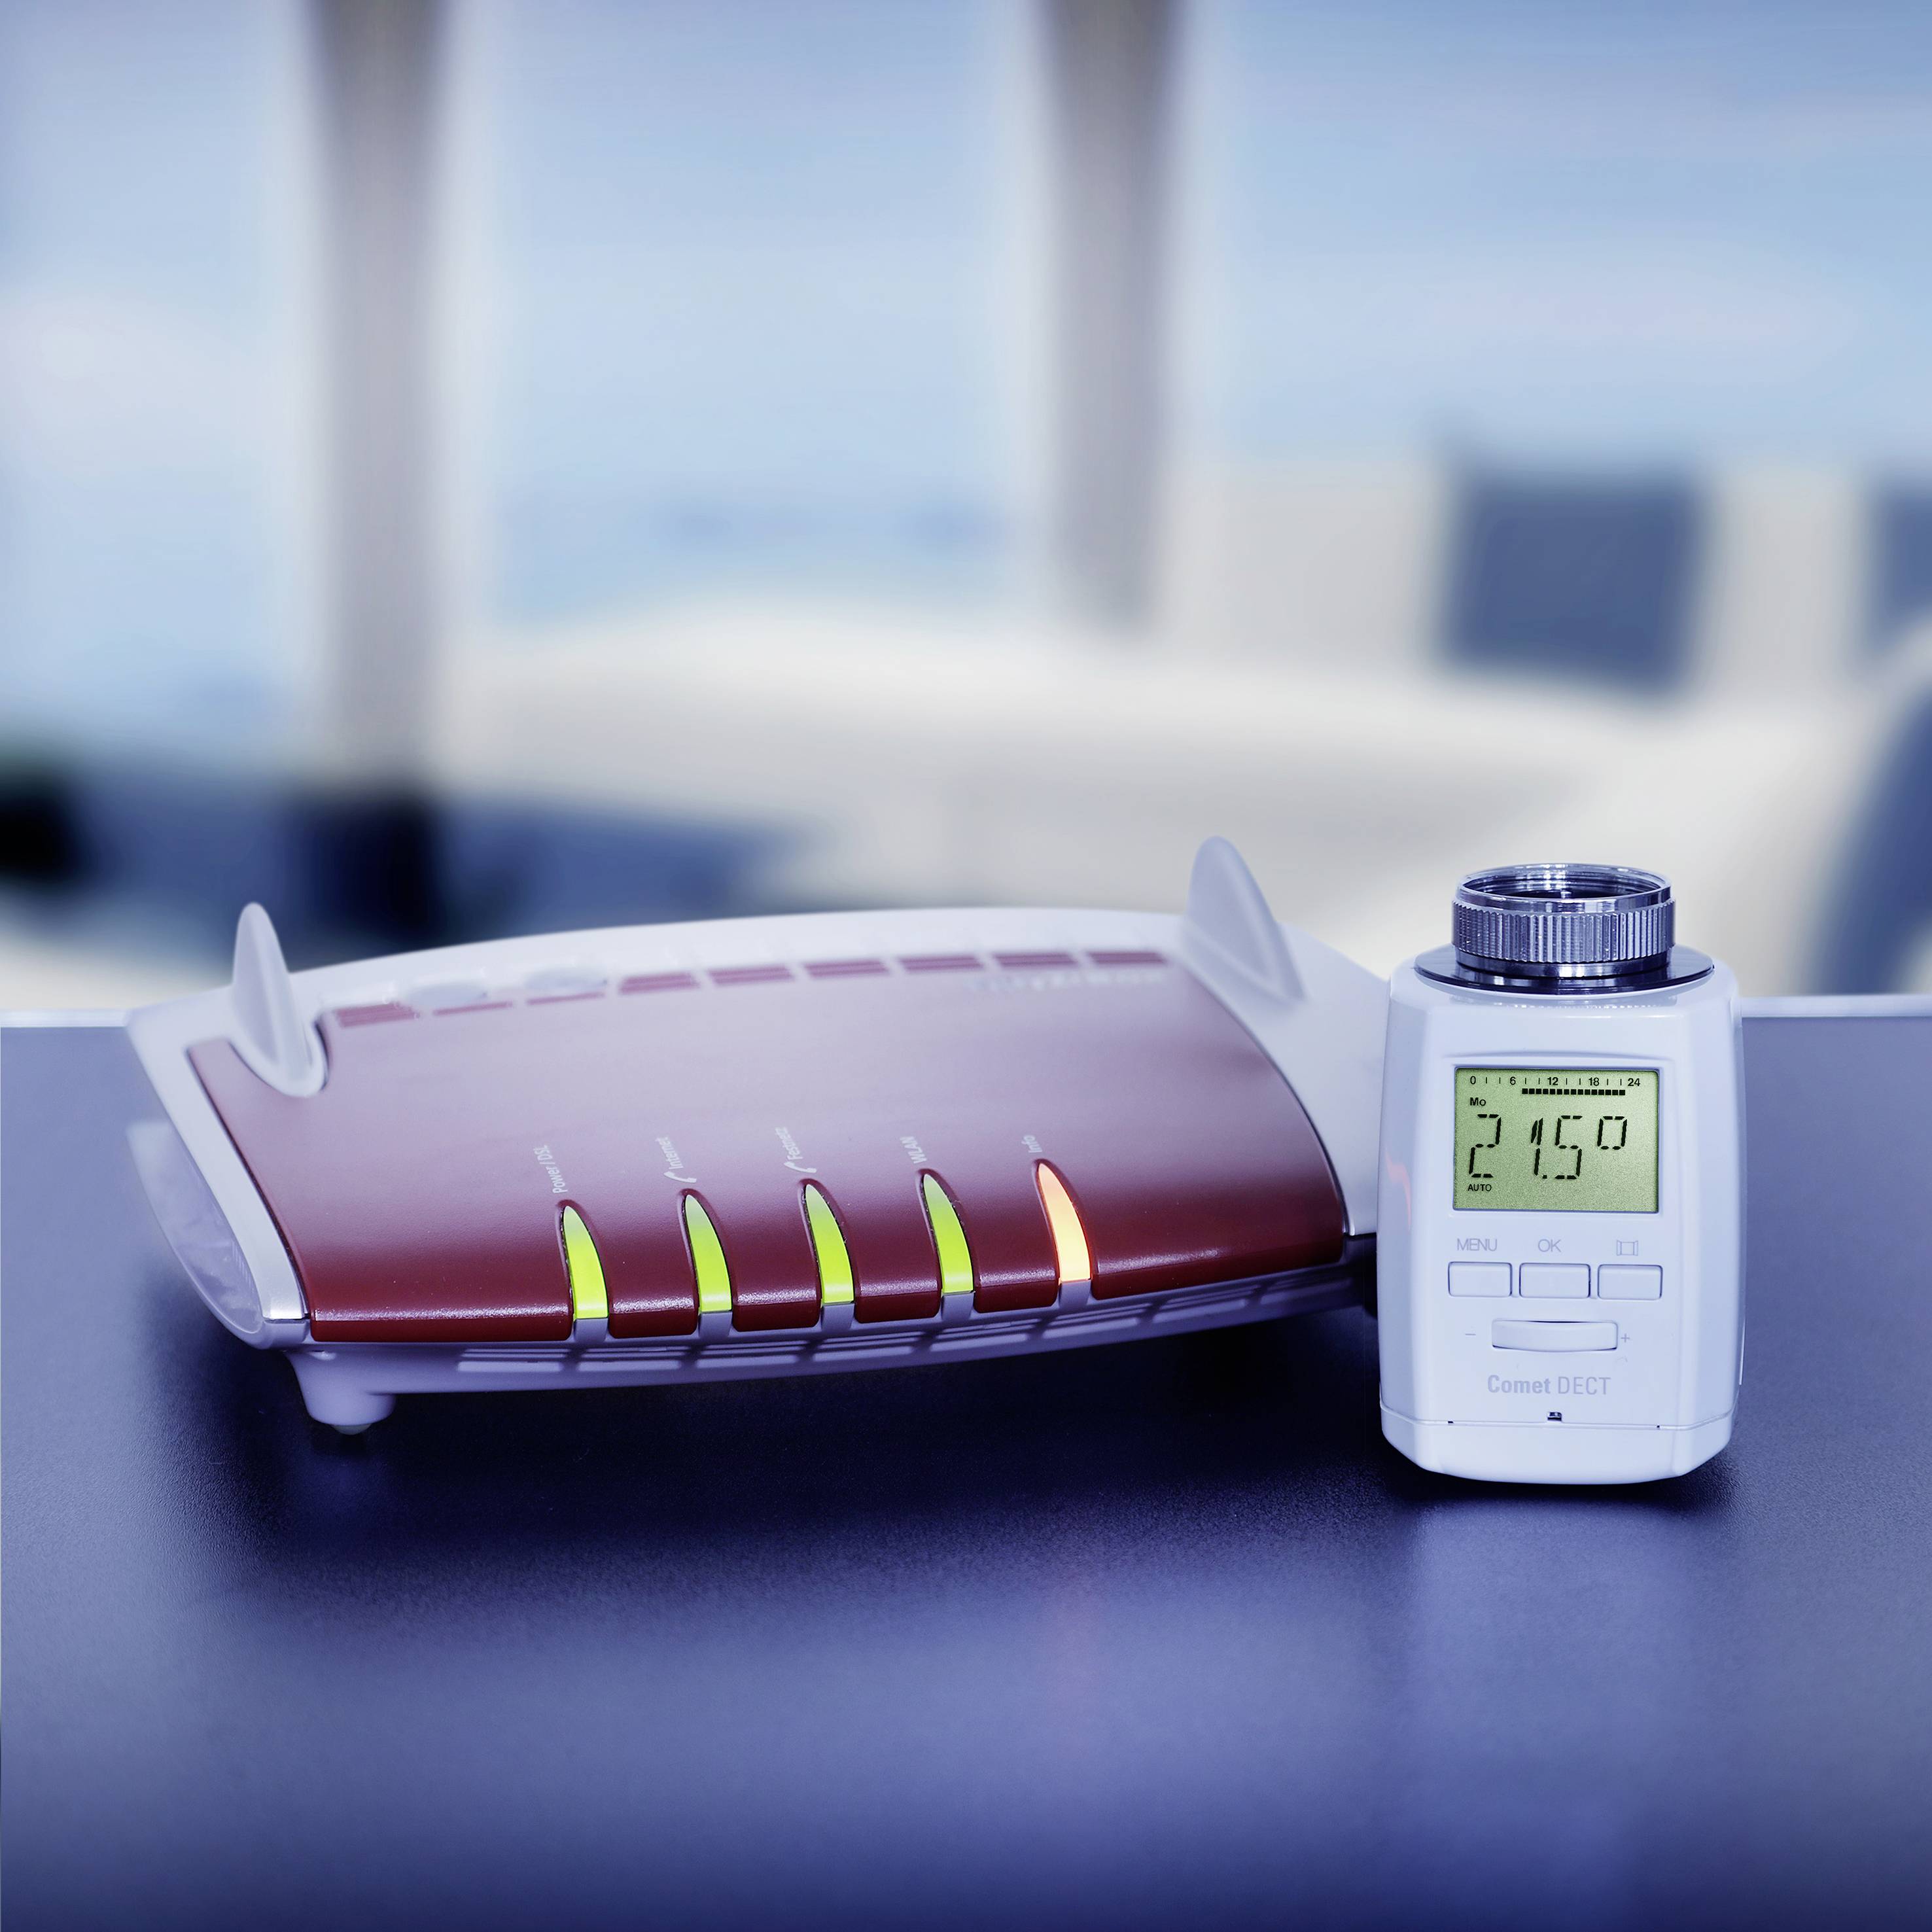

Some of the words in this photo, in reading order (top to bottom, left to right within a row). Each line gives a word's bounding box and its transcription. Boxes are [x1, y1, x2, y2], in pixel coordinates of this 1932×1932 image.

[1469, 1076, 1477, 1085] 0
[1509, 1076, 1517, 1086] 6
[1547, 1076, 1558, 1086] 12
[1588, 1077, 1600, 1087] 18
[1627, 1078, 1641, 1087] 24
[1469, 1097, 1486, 1107] Mo
[533, 1144, 553, 1161] DSL
[900, 1136, 927, 1164] WLAN
[1021, 1135, 1043, 1153] Info
[655, 1136, 684, 1170] Internet
[545, 1166, 569, 1194] Power
[1467, 1184, 1492, 1192] AUTO
[1457, 1238, 1498, 1252] MENU
[1537, 1239, 1562, 1252] OK
[1487, 1375, 1551, 1394] Comet
[1558, 1377, 1611, 1395] DECT
